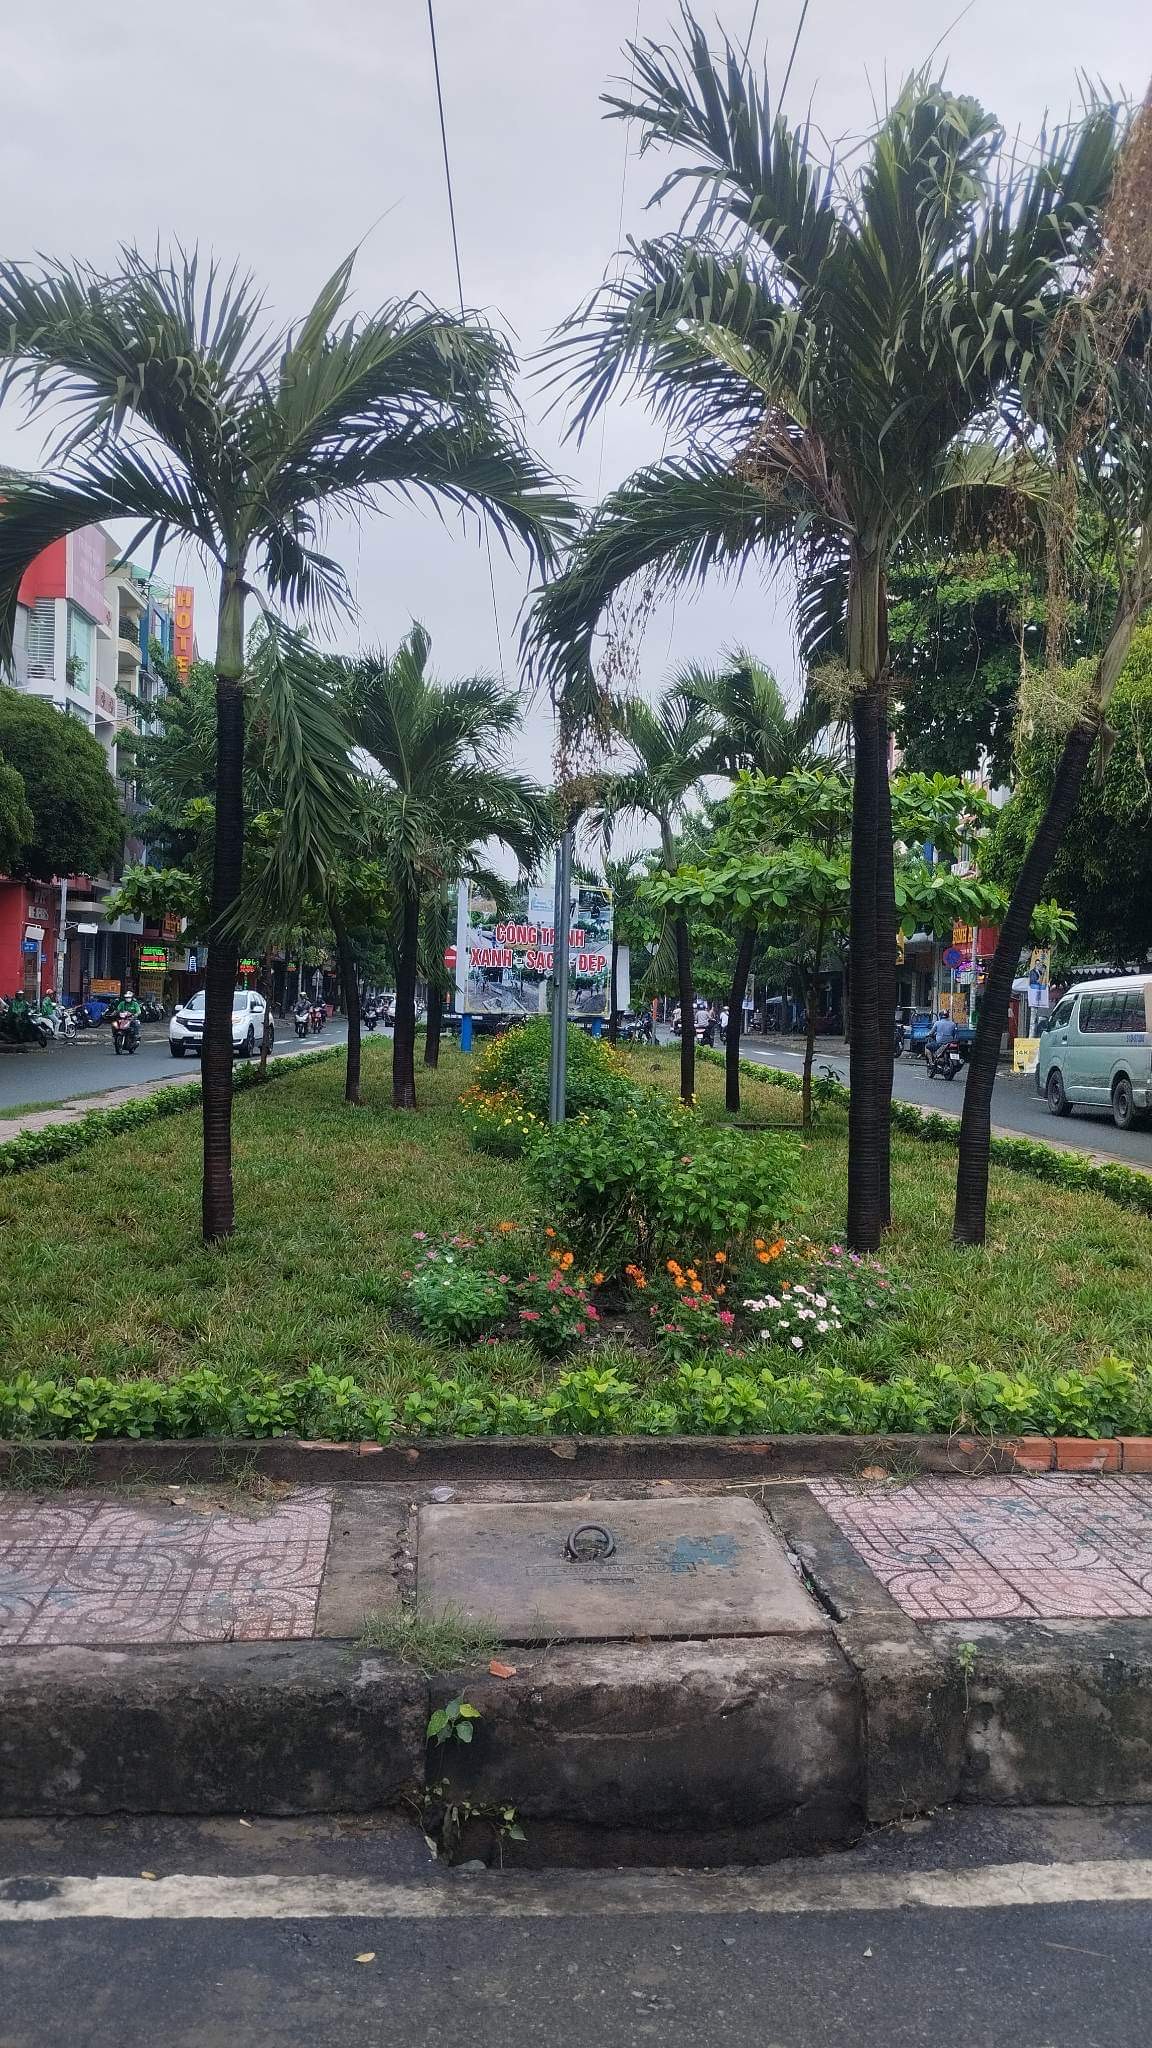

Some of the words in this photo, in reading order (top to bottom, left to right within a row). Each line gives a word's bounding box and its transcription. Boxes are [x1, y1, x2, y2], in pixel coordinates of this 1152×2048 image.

[176, 590, 192, 673] HOTE
[496, 921, 538, 944] CÔNG
[541, 927, 585, 947] TRNH
[470, 948, 513, 968] XANH
[525, 950, 554, 973] SẠC
[578, 953, 607, 976] ĐẸP
